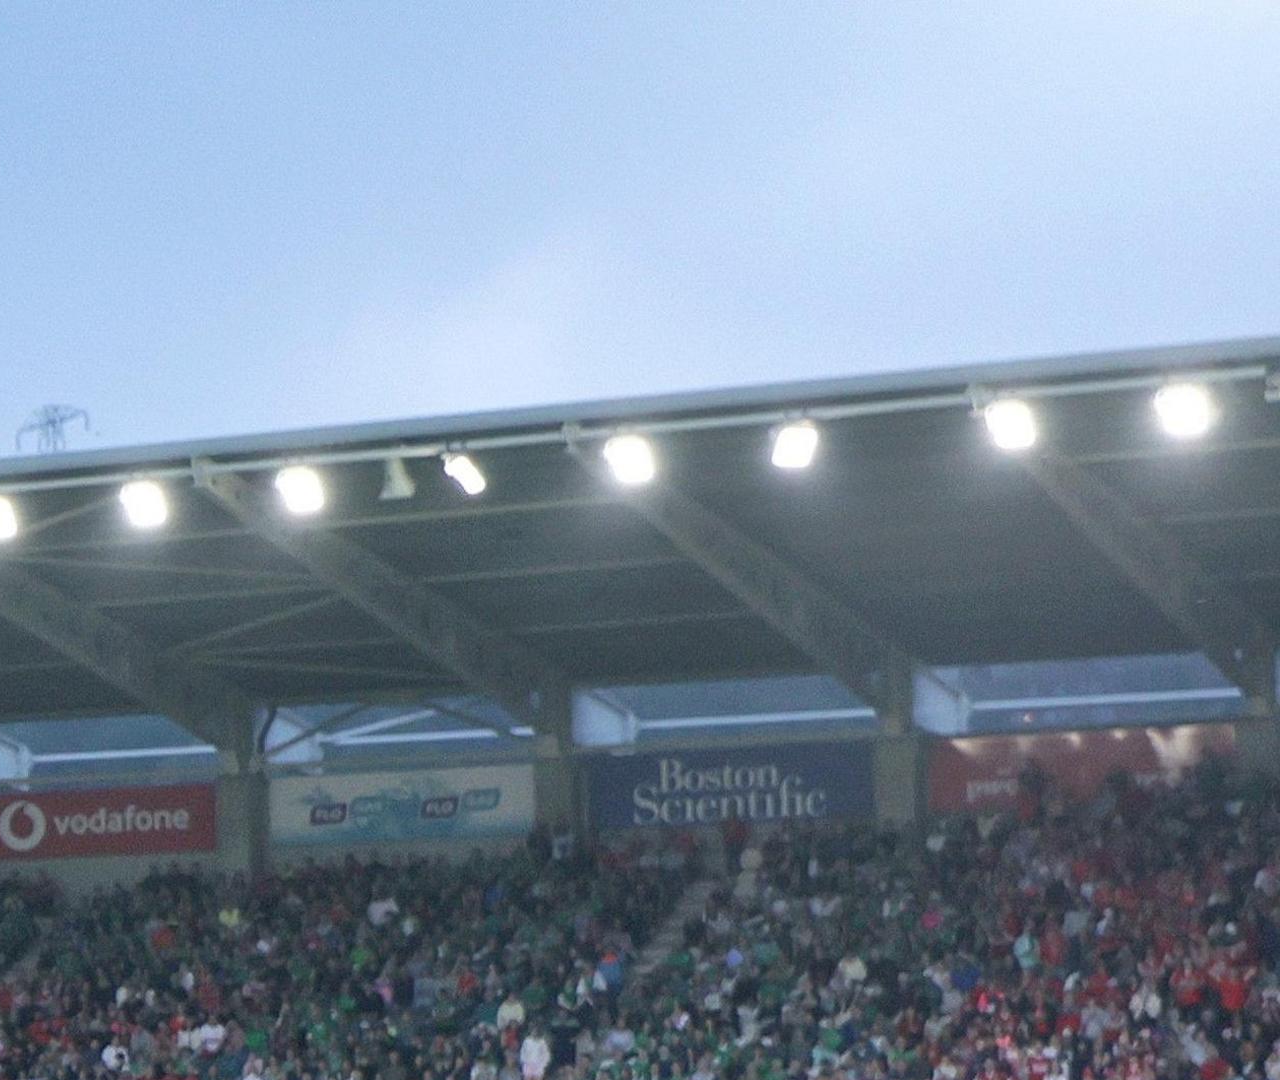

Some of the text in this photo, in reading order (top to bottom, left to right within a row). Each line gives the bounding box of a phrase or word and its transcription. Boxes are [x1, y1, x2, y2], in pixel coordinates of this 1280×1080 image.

[658, 758, 779, 792] Boston
[633, 772, 828, 824] Scientific
[53, 804, 189, 835] vodafone
